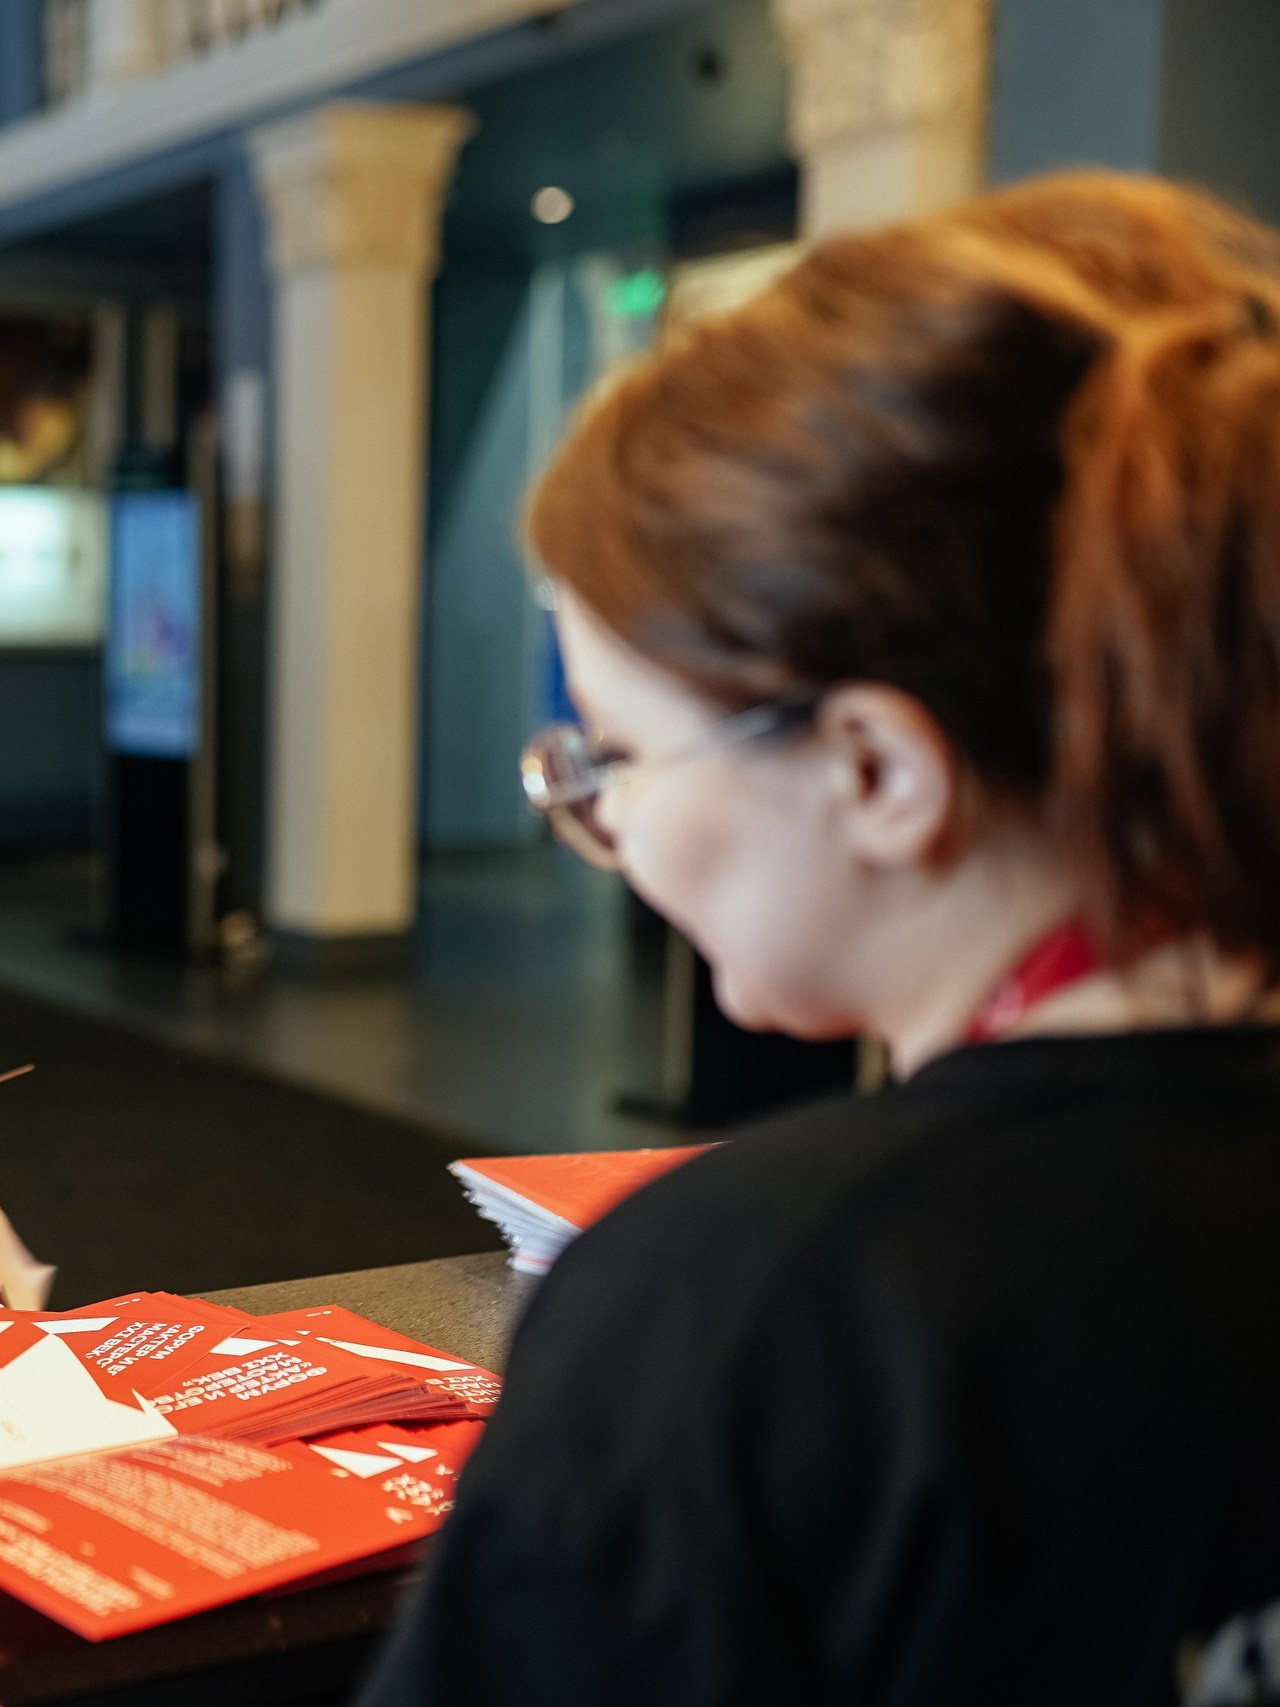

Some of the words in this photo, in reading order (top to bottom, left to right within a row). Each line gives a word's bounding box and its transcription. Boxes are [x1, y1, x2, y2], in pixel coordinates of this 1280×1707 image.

[96, 1322, 168, 1369] МАСТЕРС
[149, 1325, 205, 1360] ФОРУМ
[151, 1356, 303, 1406] МАСТЕРСТВ
[203, 1390, 226, 1401] И
[236, 1366, 328, 1401] ФОРУМ
